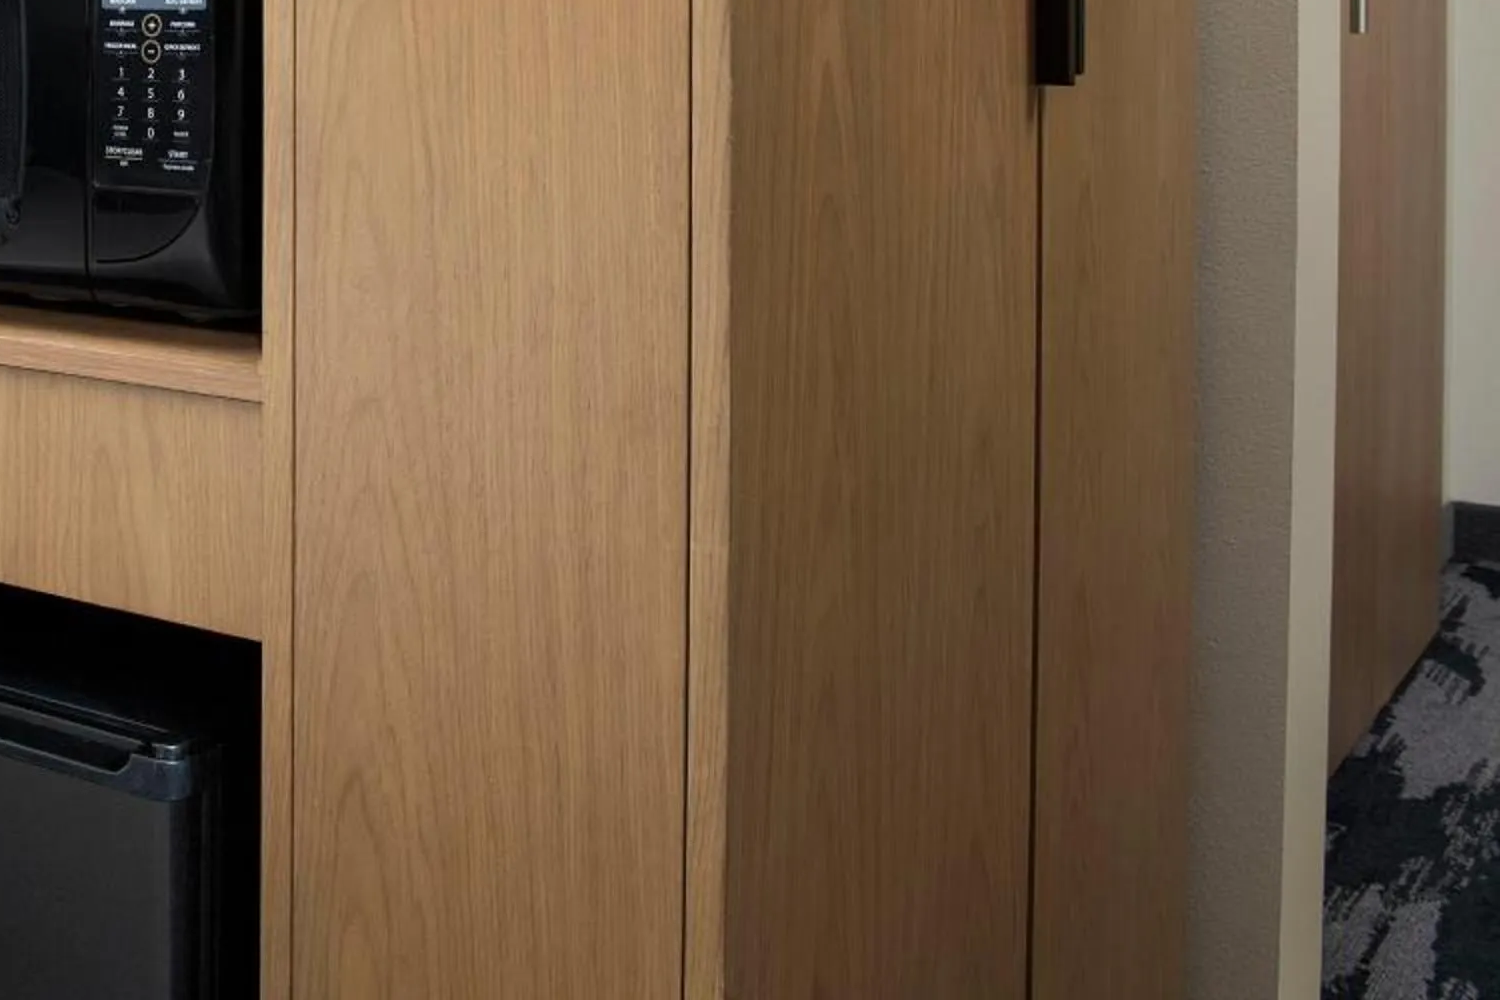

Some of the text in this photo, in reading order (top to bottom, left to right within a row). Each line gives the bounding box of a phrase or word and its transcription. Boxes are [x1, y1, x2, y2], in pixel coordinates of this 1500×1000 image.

[118, 67, 125, 79] 1
[147, 67, 155, 79] 2
[117, 86, 125, 97] 4
[147, 87, 155, 99] 5
[177, 89, 185, 101] 6
[147, 107, 155, 119] 8
[177, 109, 185, 121] 9
[147, 127, 155, 139] 0
